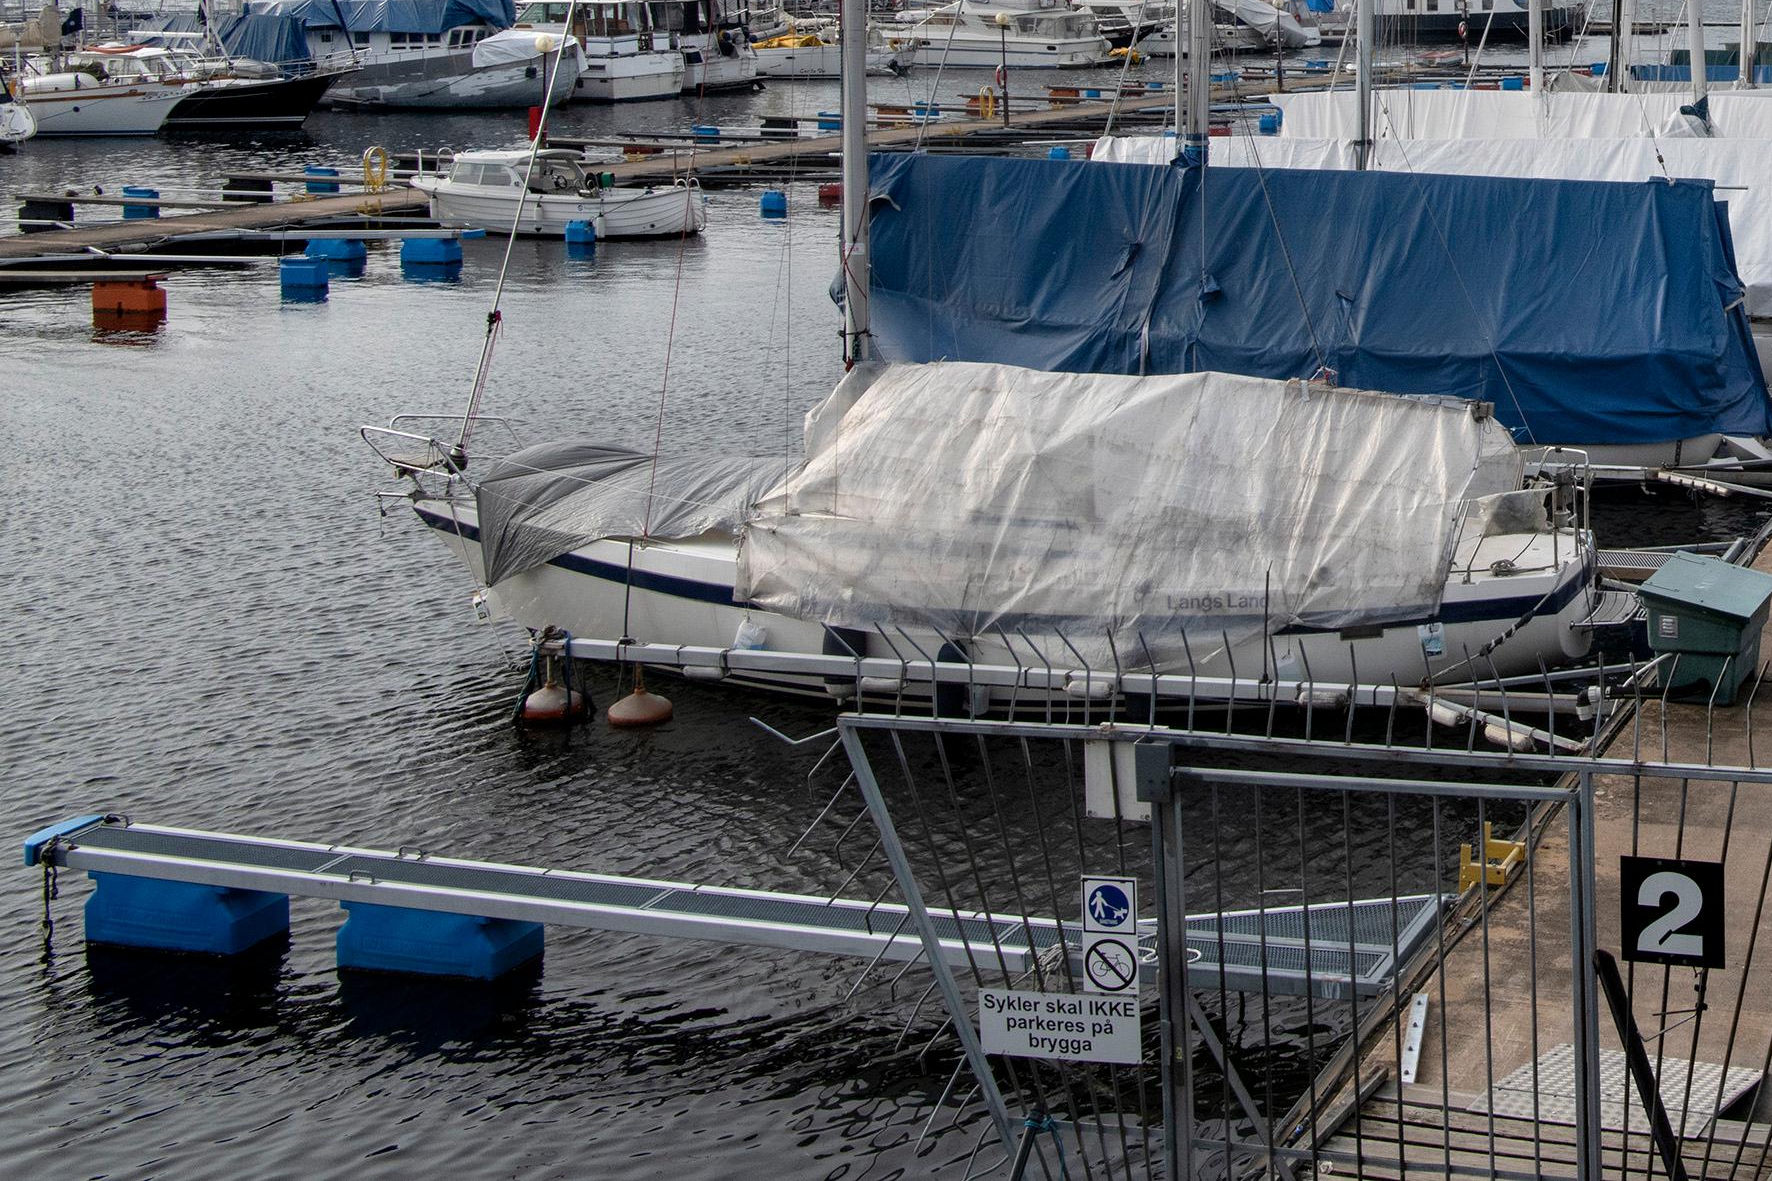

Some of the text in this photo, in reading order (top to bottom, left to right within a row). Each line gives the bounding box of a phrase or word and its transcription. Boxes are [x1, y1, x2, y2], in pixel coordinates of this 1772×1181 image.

[1167, 593, 1223, 612] Langs
[1637, 871, 1703, 956] 2
[984, 993, 1136, 1017] Sykler skal IKKE
[1006, 1015, 1114, 1036] parkeres på
[1028, 1032, 1093, 1054] brygga
